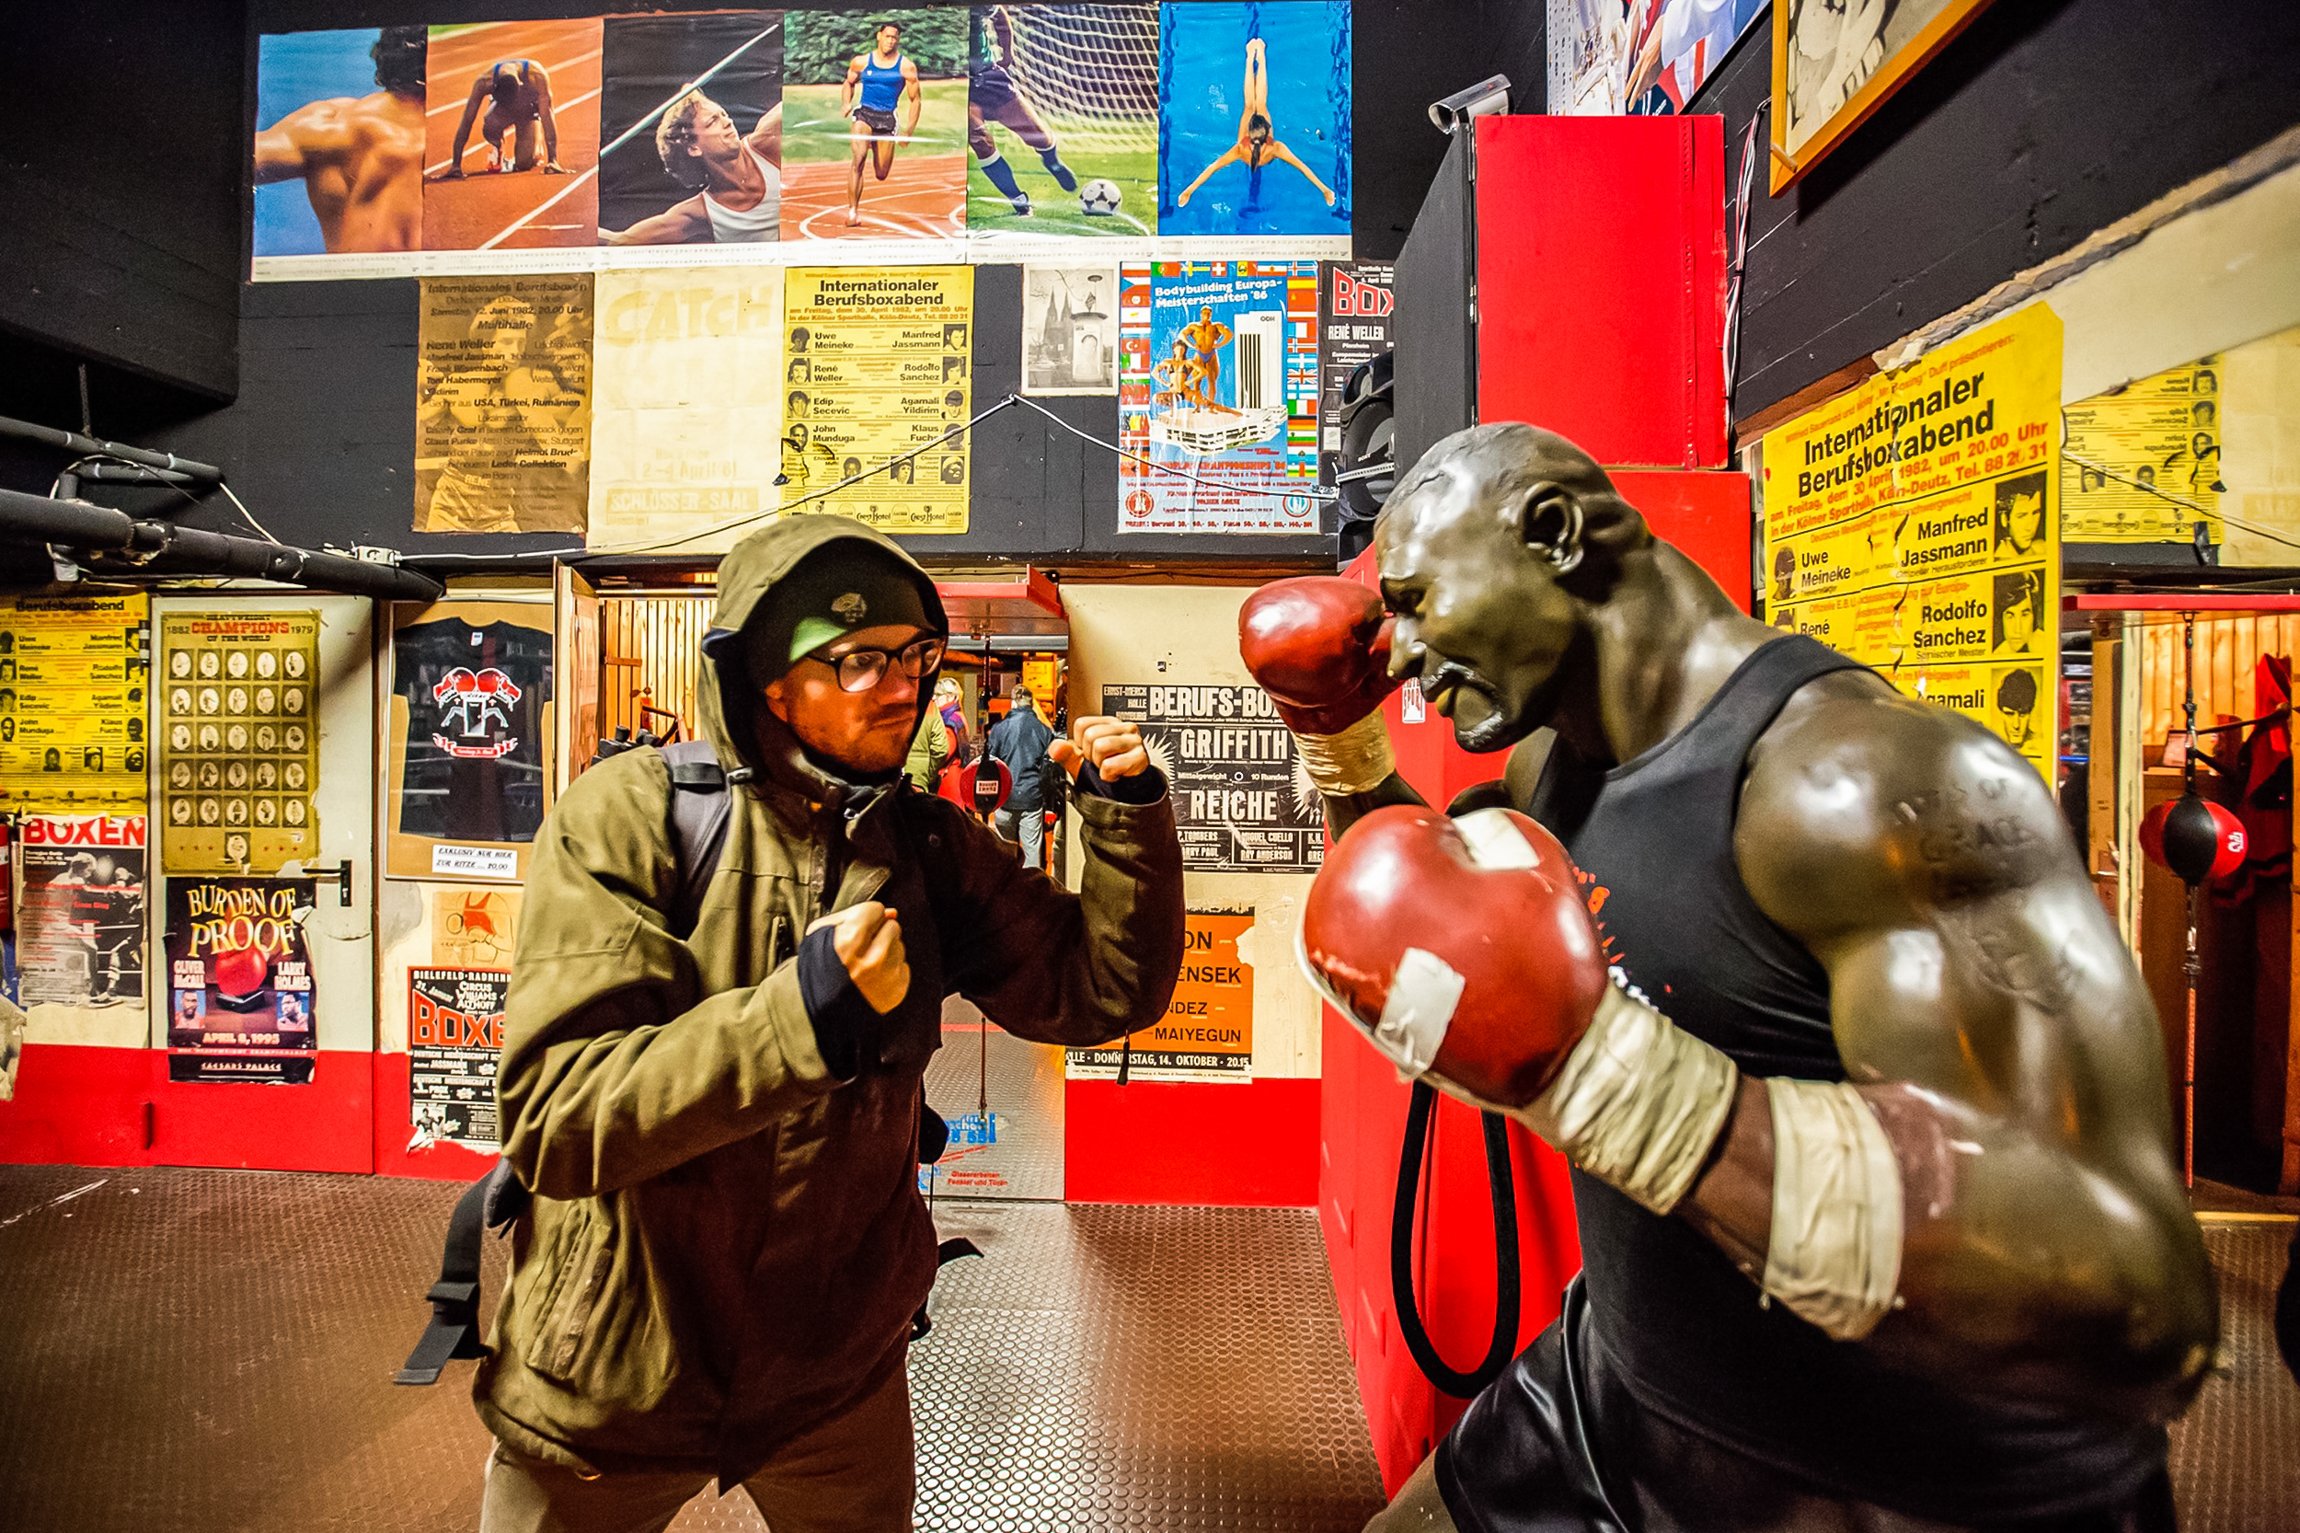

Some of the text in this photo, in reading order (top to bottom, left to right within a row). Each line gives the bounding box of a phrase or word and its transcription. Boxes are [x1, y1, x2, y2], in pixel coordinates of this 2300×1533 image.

[820, 279, 939, 292] Internationaler
[1155, 279, 1283, 297] Bodybuilding Europa-
[814, 293, 944, 306] Berufsboxabend
[1156, 292, 1249, 308] Meisterschaften
[605, 285, 773, 347] CATCH
[815, 332, 836, 340] Uwe
[902, 331, 941, 339] Manfred
[1328, 323, 1384, 341] RENÉ WELLER
[459, 339, 496, 350] Weller
[892, 341, 941, 349] Jassmann
[814, 365, 838, 373] René
[905, 363, 940, 372] Rodolfo
[814, 374, 843, 382] Weller
[900, 373, 940, 382] Sanchez
[474, 399, 496, 408] USA,
[532, 398, 580, 407] Rumänien
[814, 398, 834, 407] Edip
[901, 397, 939, 406] Agamali
[813, 407, 850, 415] Secevic
[903, 406, 939, 414] Yildirim
[1805, 371, 1984, 466] Internationaler
[813, 425, 836, 433] John
[912, 424, 939, 432] Klaus
[813, 435, 855, 444] Munduga
[1798, 398, 1994, 498] Berufsboxabend
[1827, 490, 1848, 504] dem
[1939, 450, 1960, 467] um
[1968, 432, 2009, 455] 20.00
[2017, 422, 2048, 442] Uhr
[1781, 522, 1794, 534] der
[1797, 512, 1827, 530] Kölner
[1955, 462, 1981, 481] Tel.
[1985, 455, 2004, 473] 88
[2029, 441, 2048, 460] 31
[1918, 507, 1988, 541] Manfred
[1801, 551, 1829, 568] Uwe
[1901, 538, 1988, 568] Jassmann
[1801, 566, 1851, 588] Meineke
[1921, 599, 1988, 625] Rodolfo
[167, 622, 313, 635] 1882 CHAMPIONS 1979
[1800, 619, 1830, 635] René
[1913, 627, 1987, 649] Sanchez
[1150, 686, 1281, 718] BERUFS-BO
[1924, 689, 1985, 709] gamali
[1180, 728, 1288, 760] GRIFFITH
[1177, 772, 1228, 781] Mittelgewicht
[1261, 773, 1290, 781] Runden
[1190, 790, 1278, 821] REICHE
[24, 817, 146, 846] BOXEN
[186, 885, 297, 918] BURDEN OF
[187, 916, 297, 958] PROOF
[413, 970, 465, 980] BIELEFELD
[274, 976, 312, 991] HOLMES
[202, 1032, 236, 1044] APRIL
[1154, 1027, 1242, 1043] MAIYEGUN
[1094, 1052, 1249, 1068] DONNRSTAG, 14. OKTOBER 20.15
